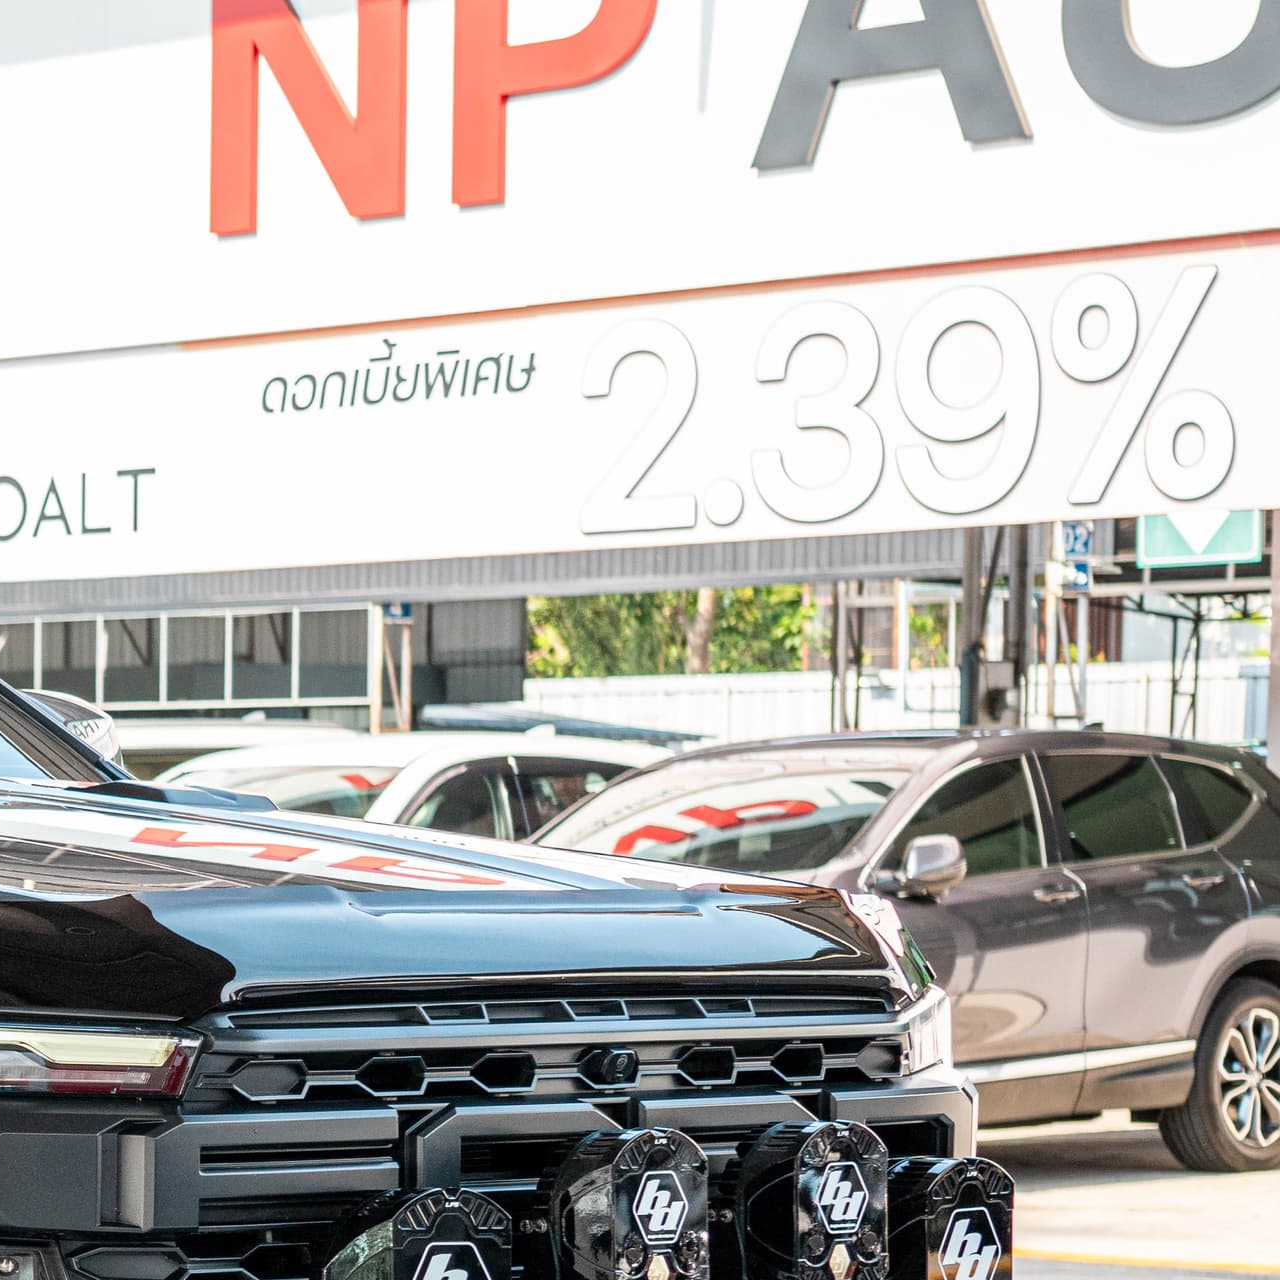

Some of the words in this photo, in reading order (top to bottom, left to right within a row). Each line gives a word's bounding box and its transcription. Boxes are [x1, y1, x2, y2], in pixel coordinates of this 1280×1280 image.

[210, 0, 657, 238] NP
[262, 338, 536, 413] ดอกเบี้ยพิเศษ
[581, 263, 1236, 534] 2.39%
